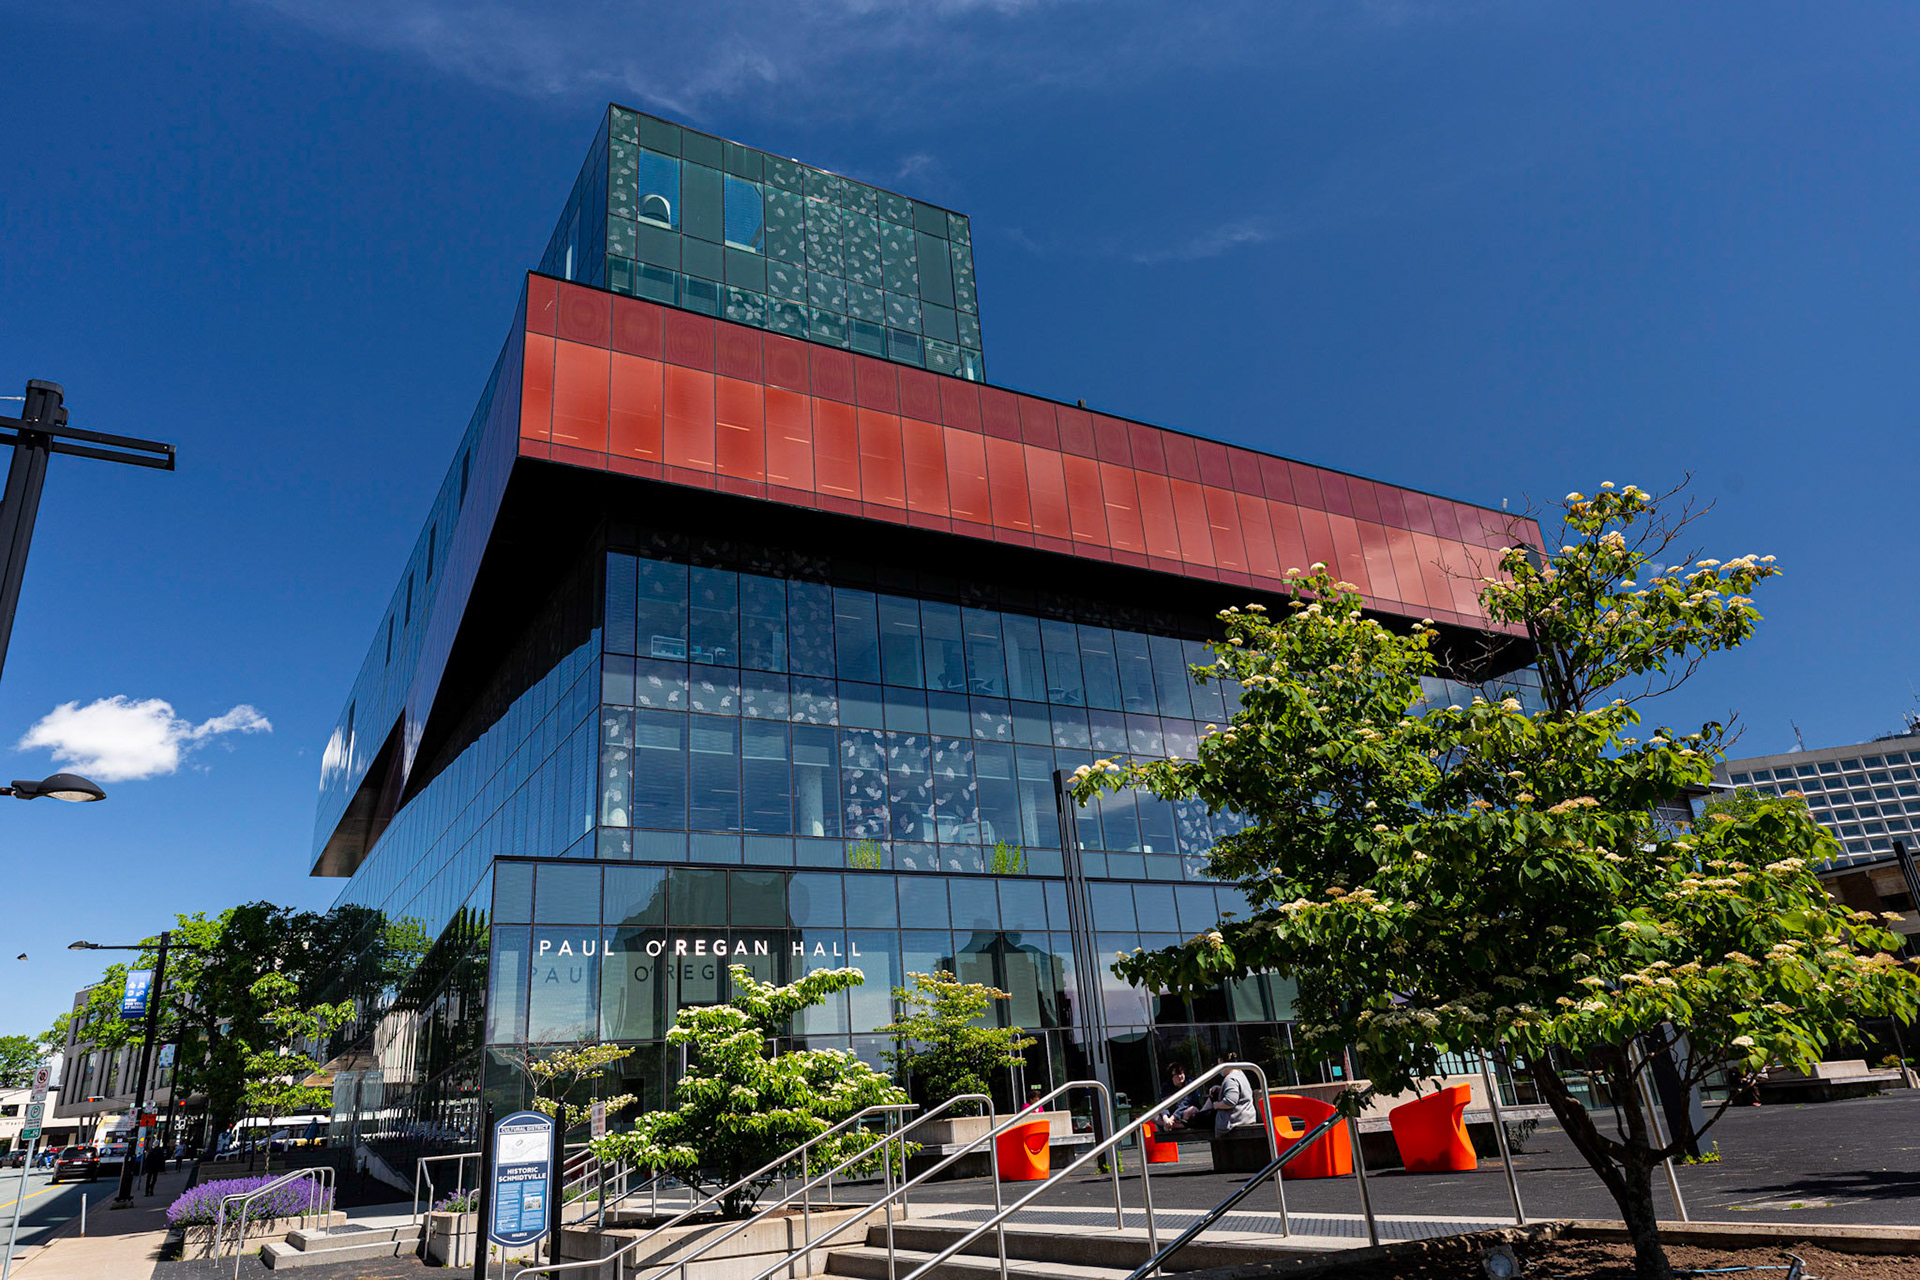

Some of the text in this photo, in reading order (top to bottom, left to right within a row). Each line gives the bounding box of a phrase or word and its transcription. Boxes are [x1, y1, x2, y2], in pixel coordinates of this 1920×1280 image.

[539, 939, 862, 957] PAUL O'REGAN HALL
[526, 1124, 549, 1132] DISTRICT
[507, 1166, 539, 1175] HISTORIC
[498, 1172, 547, 1182] SCHMIDTVILLE
